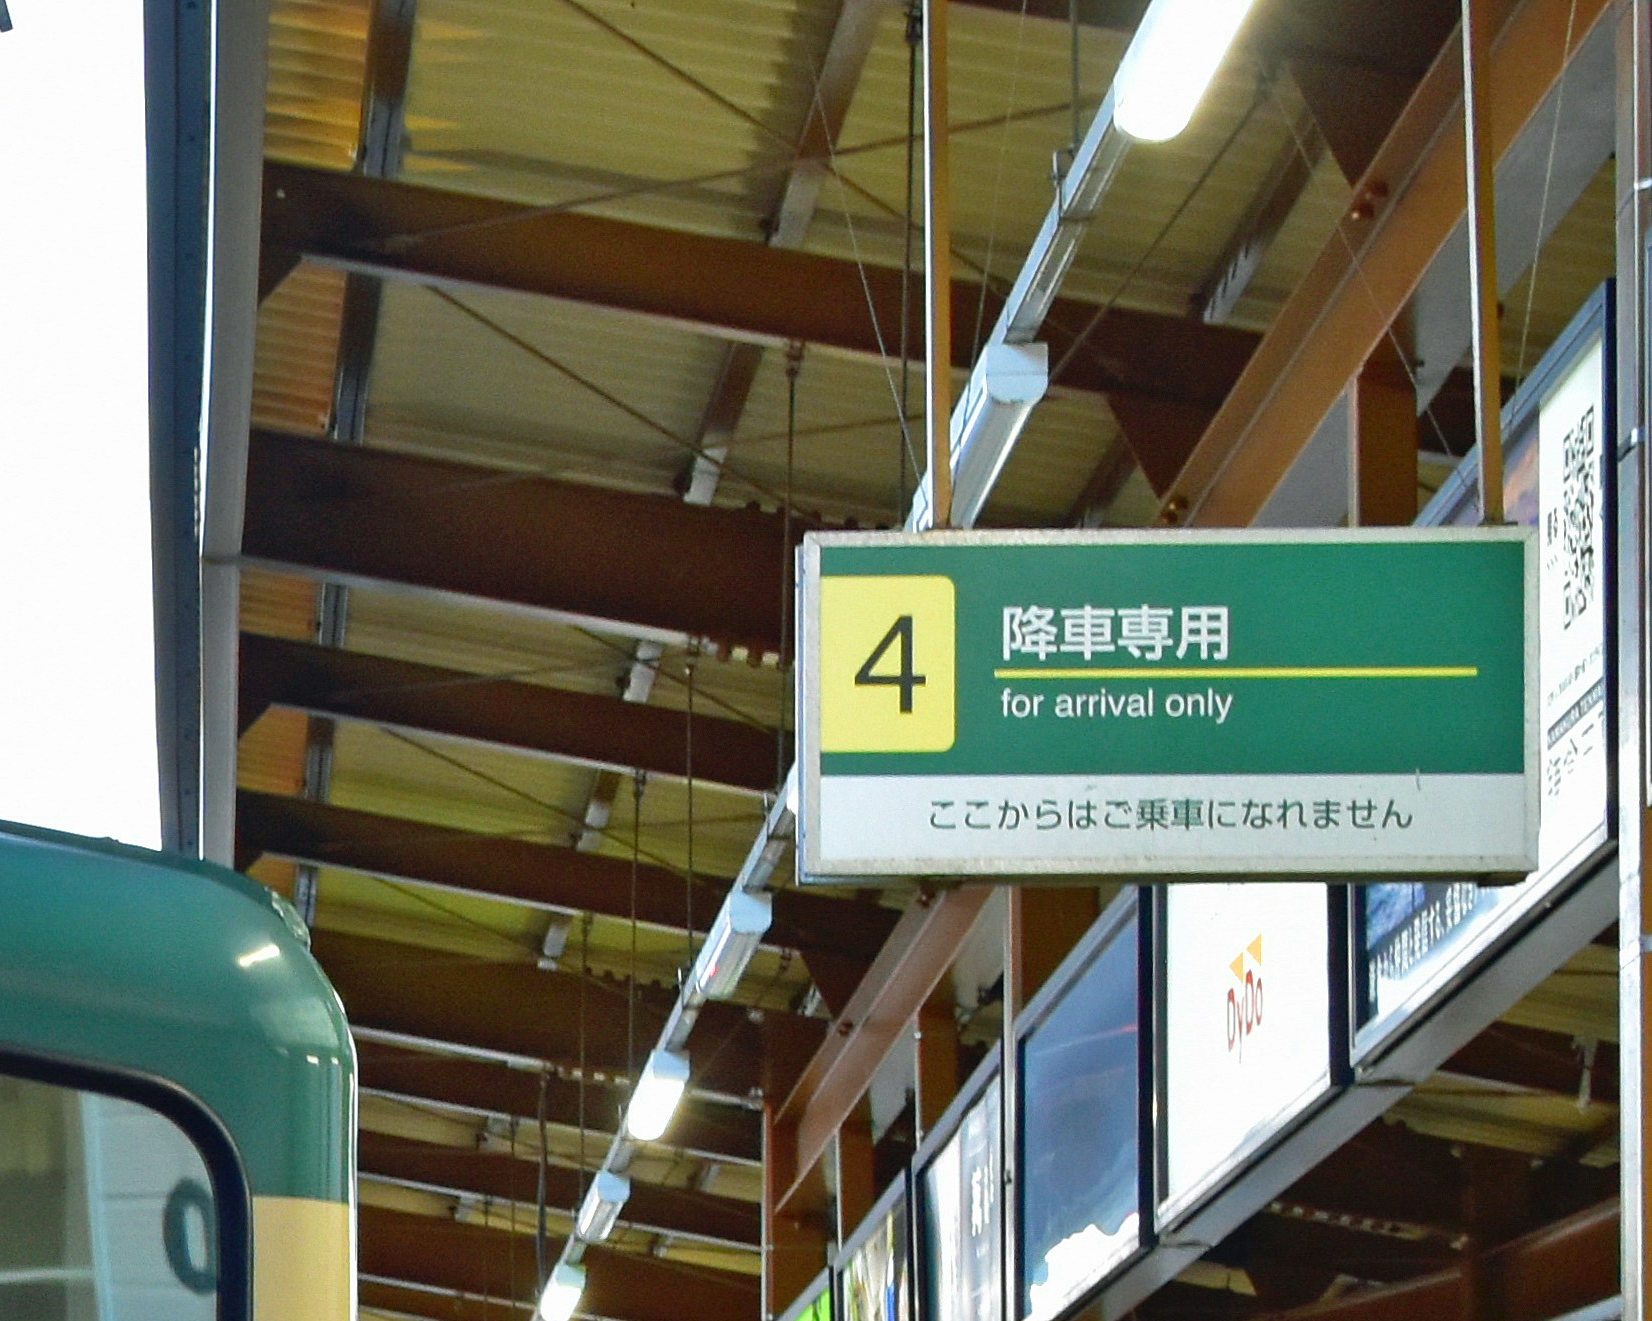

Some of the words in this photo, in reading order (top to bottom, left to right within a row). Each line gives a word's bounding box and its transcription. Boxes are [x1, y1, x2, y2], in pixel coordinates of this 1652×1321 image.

[1001, 605, 1230, 662] 降車専用
[854, 614, 927, 715] 4
[1001, 687, 1045, 718] for
[1054, 687, 1154, 718] arrival
[1164, 687, 1234, 724] only
[929, 798, 1414, 832] ここからはご乗車になれません
[1227, 968, 1263, 1064] DyDo
